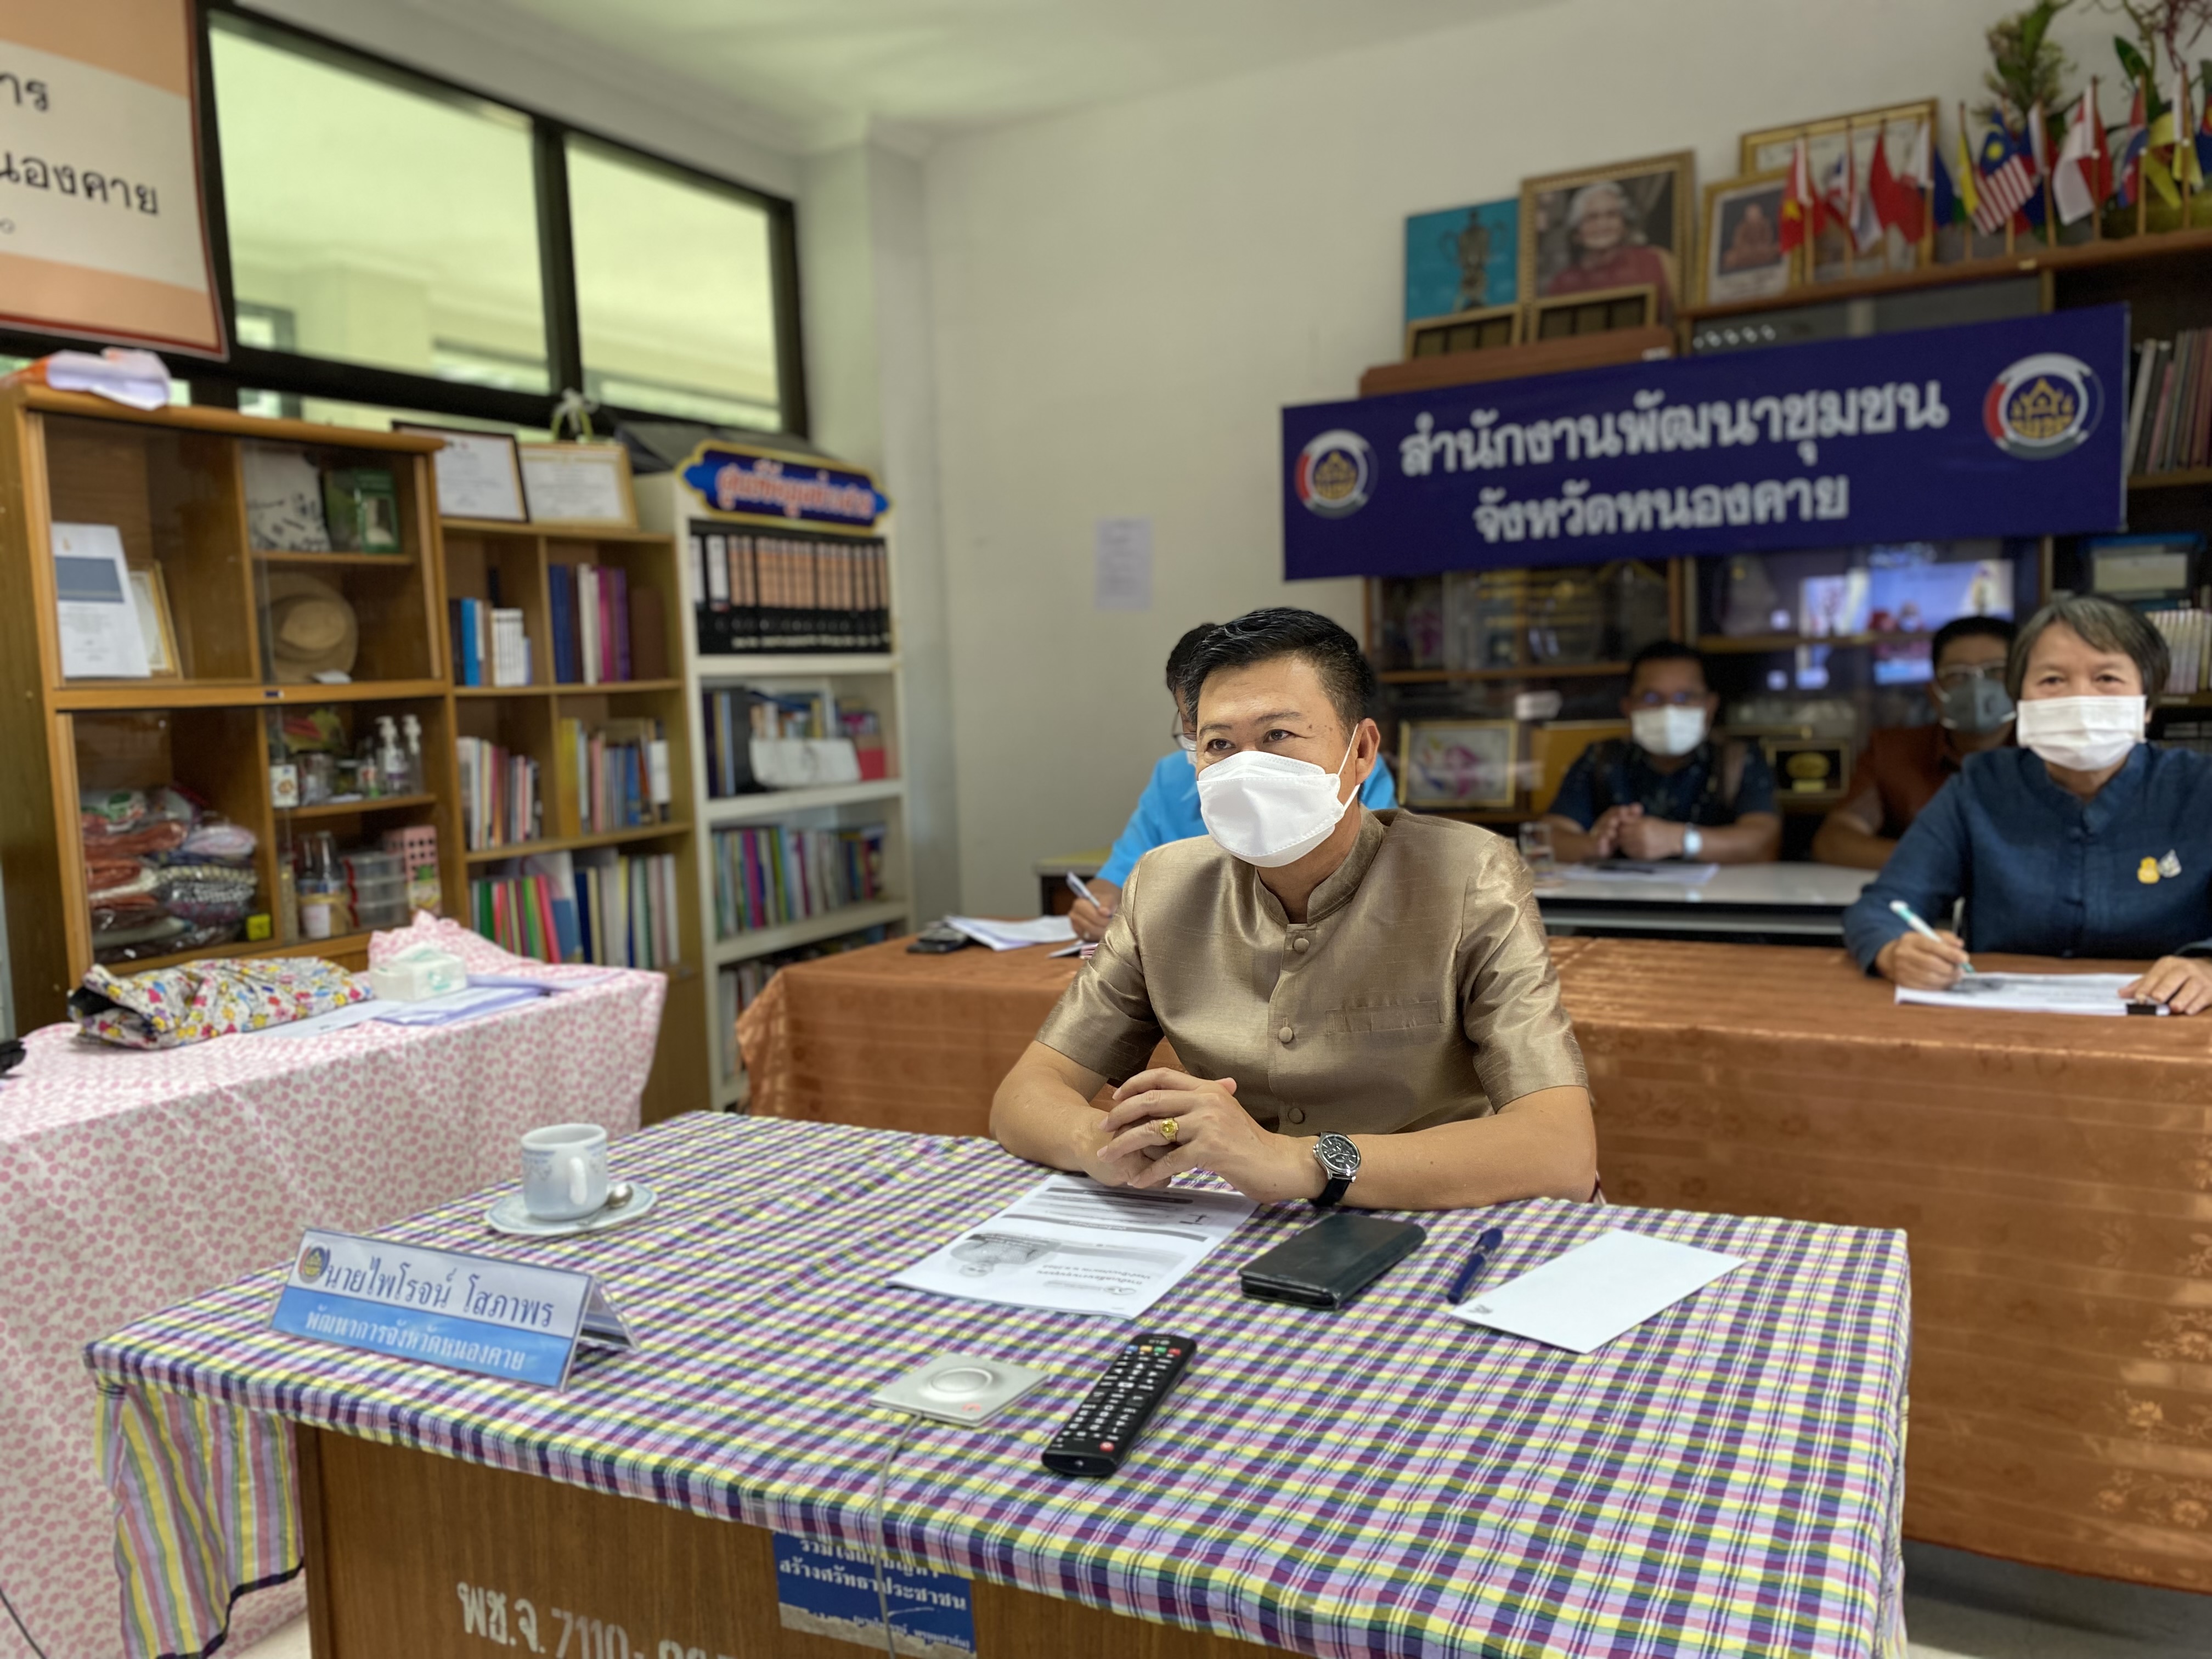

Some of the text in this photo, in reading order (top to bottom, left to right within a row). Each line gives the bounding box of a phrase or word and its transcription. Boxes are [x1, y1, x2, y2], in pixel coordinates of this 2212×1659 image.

[1400, 380, 1949, 477] สำนักงานพัฒนาชุมชน
[1472, 475, 1849, 544] จังหวัดหนองคาย
[325, 1256, 554, 1328] นายไพโรจน์ โสภาพร
[305, 1304, 527, 1371] พัฒนาการจังหวัดหนองคาย
[456, 1581, 546, 1654] พช.จ.
[778, 1556, 967, 1611] สร้างศรัทธาประชาชน
